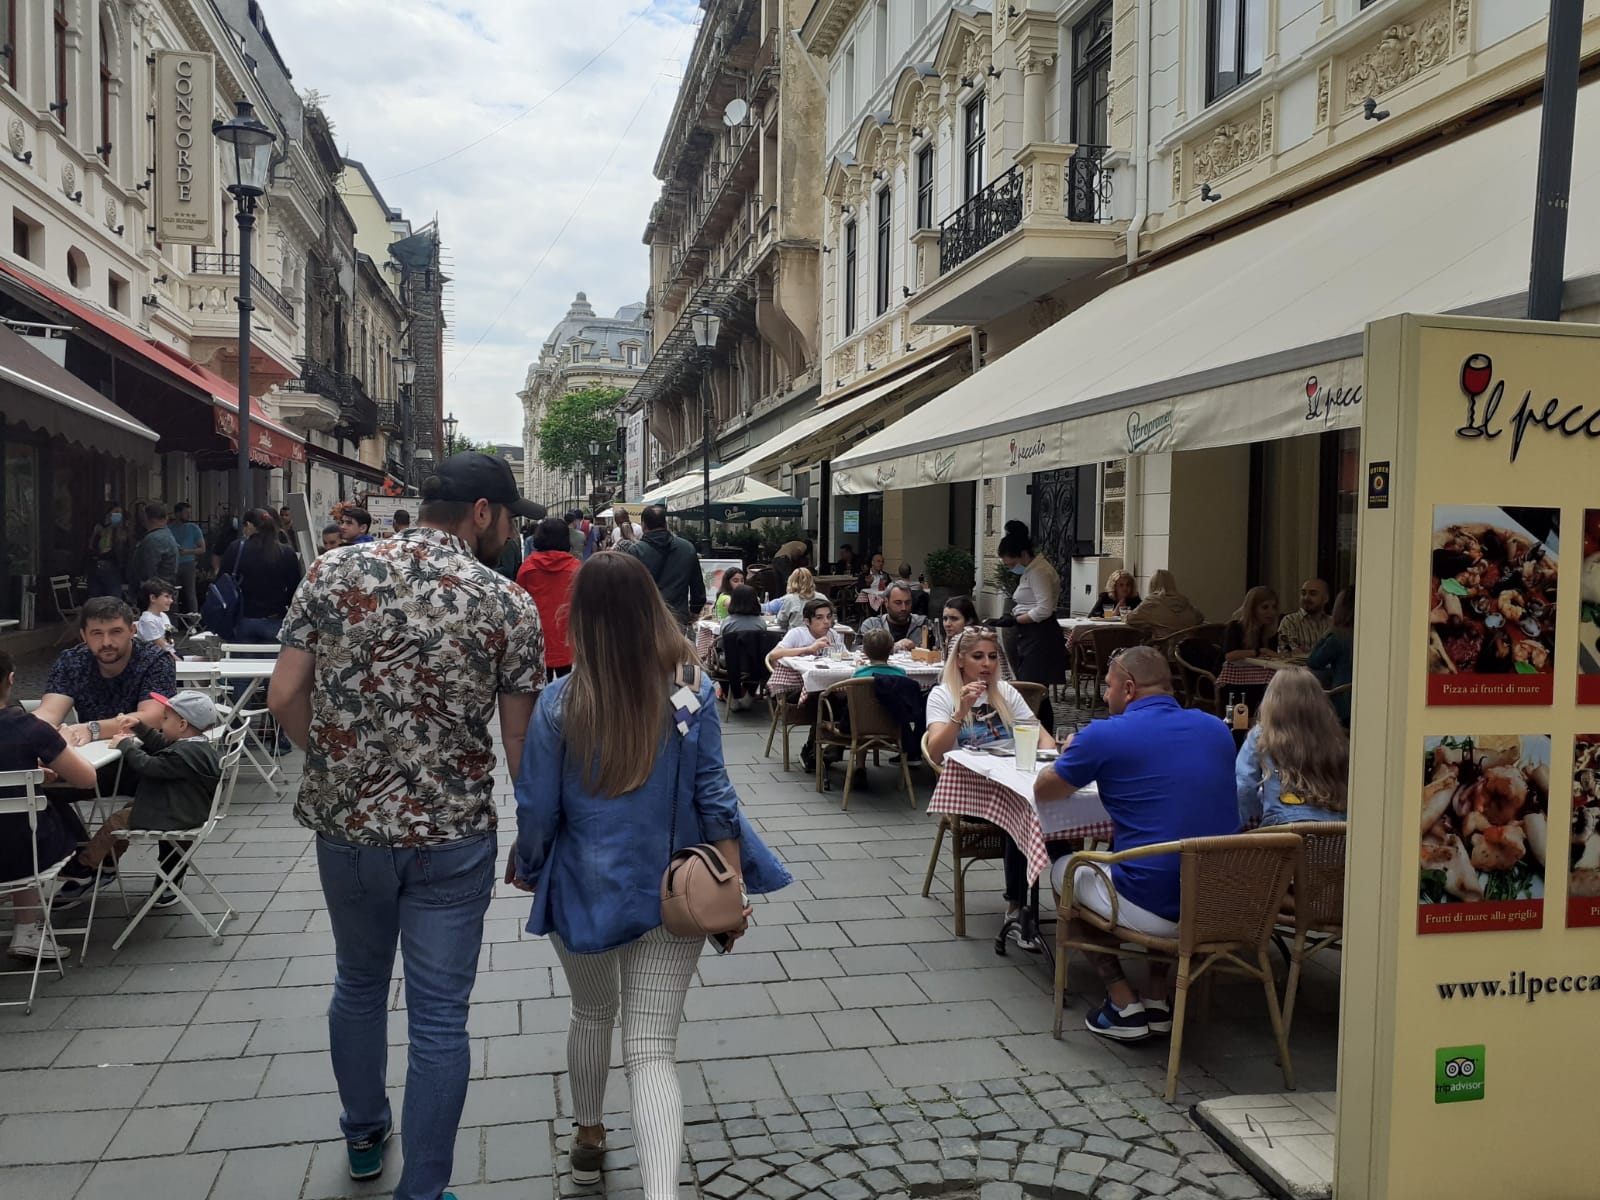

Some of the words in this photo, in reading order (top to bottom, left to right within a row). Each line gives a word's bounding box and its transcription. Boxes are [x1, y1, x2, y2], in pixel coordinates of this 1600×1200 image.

[175, 60, 193, 202] CONCORDE
[1443, 684, 1467, 694] Pizza
[1470, 684, 1478, 693] ai
[1480, 684, 1504, 693] frutti
[1505, 683, 1515, 693] di
[1517, 685, 1540, 693] mare
[1425, 913, 1452, 923] Frutti
[1453, 912, 1463, 922] di
[1465, 912, 1488, 921] mare
[1490, 911, 1506, 920] alla
[1508, 909, 1537, 921] griglia
[1436, 1081, 1481, 1093] tripadvisor
